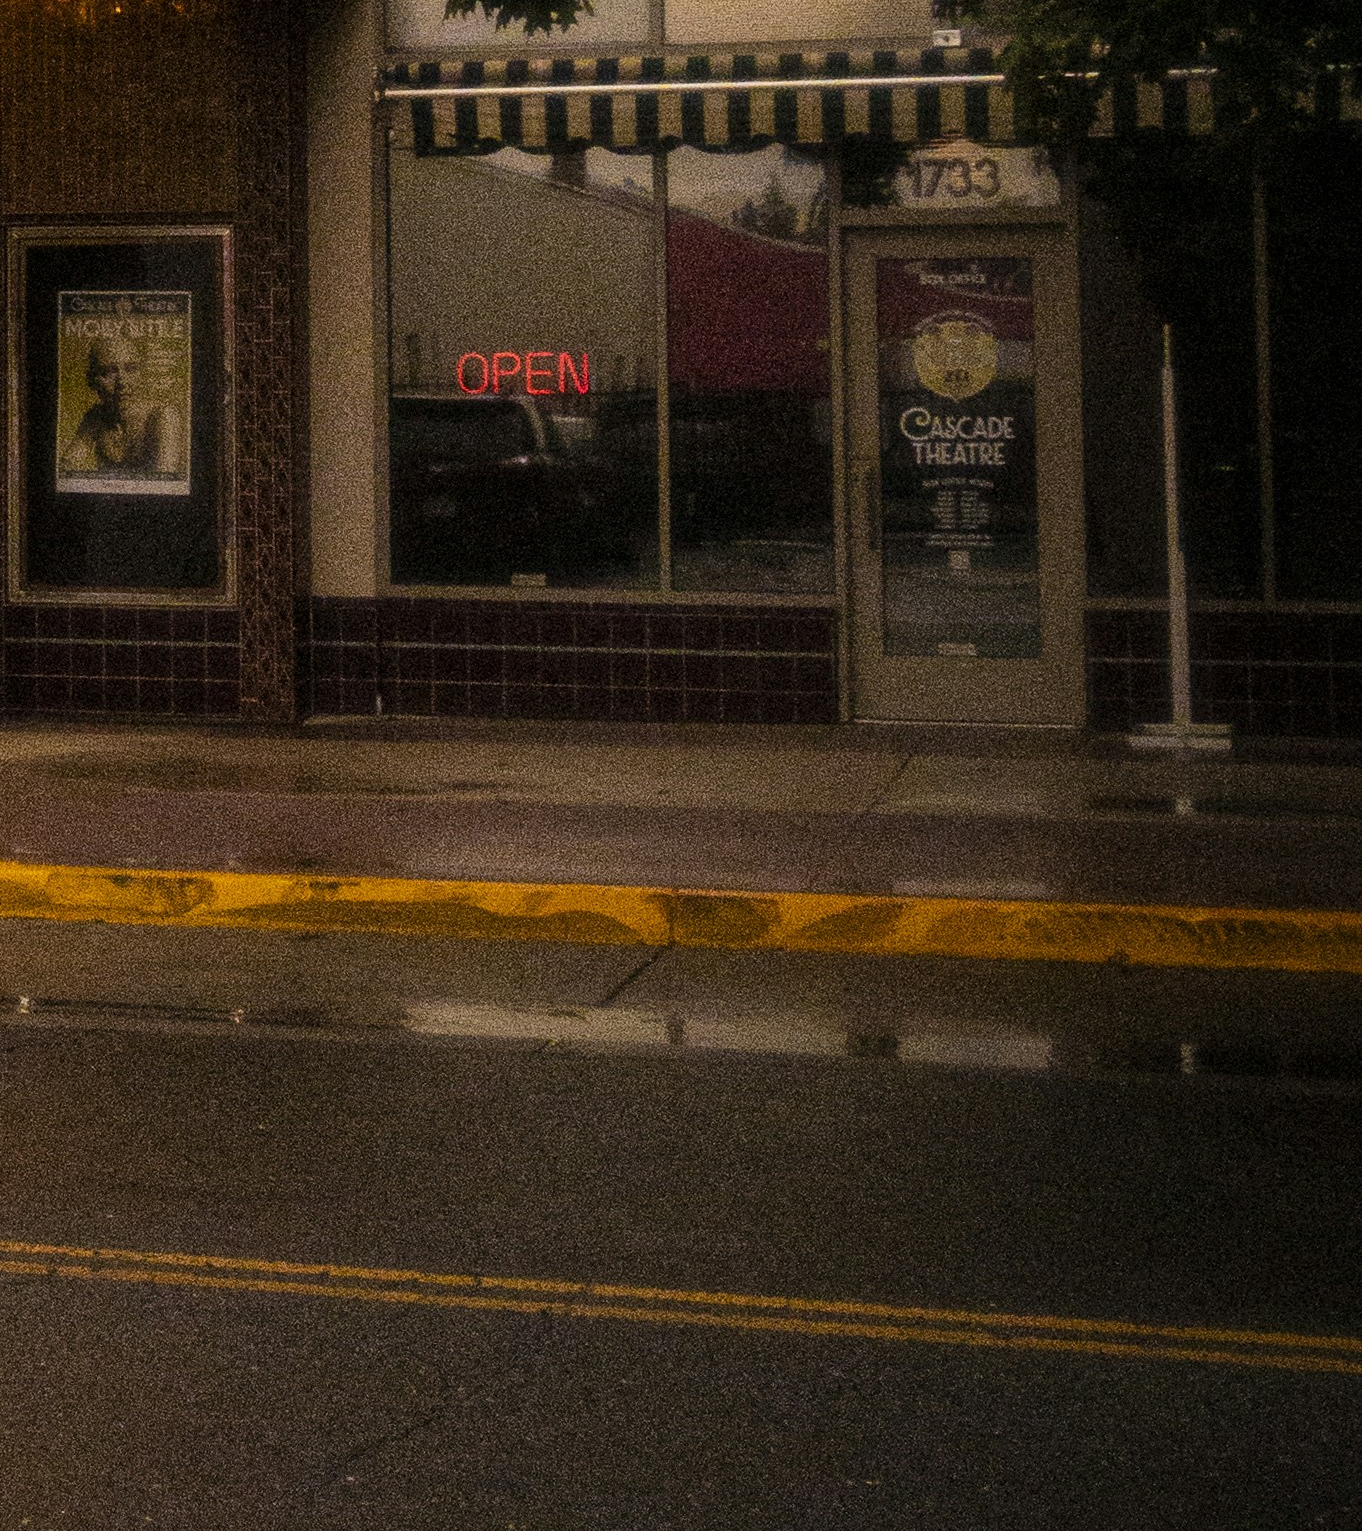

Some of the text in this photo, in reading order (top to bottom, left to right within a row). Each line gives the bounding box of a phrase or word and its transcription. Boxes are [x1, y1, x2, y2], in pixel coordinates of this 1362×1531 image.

[906, 157, 1001, 198] 1733
[455, 350, 590, 396] OPEN
[912, 442, 1006, 466] THEATRE
